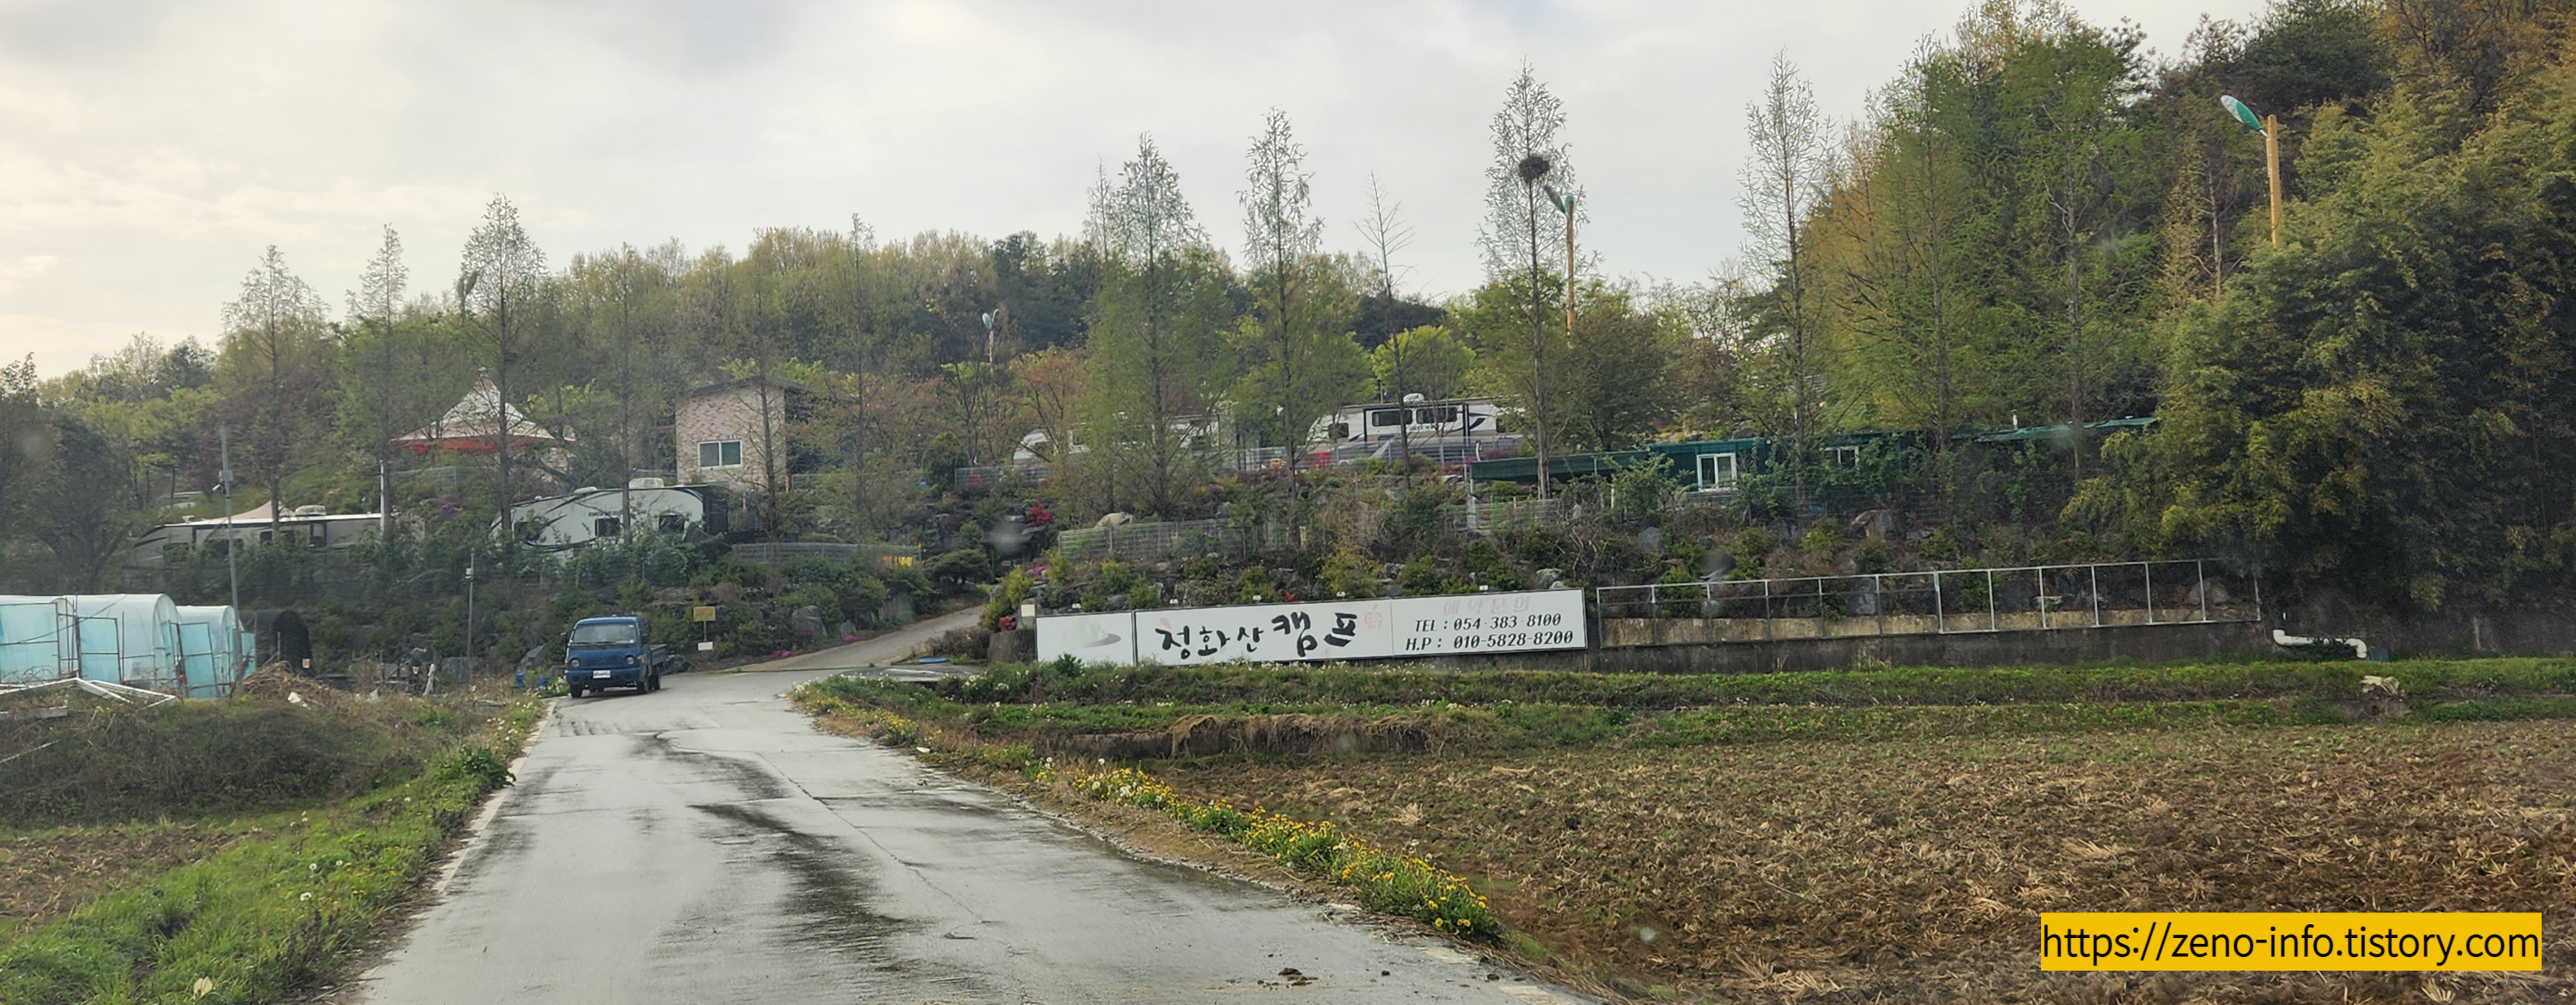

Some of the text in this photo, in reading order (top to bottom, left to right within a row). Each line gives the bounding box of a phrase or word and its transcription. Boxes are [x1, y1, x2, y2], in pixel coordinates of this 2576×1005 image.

[1272, 611, 1358, 658] 캠프
[1415, 619, 1437, 632] TEL
[1453, 630, 1573, 649] 010-5828-8200
